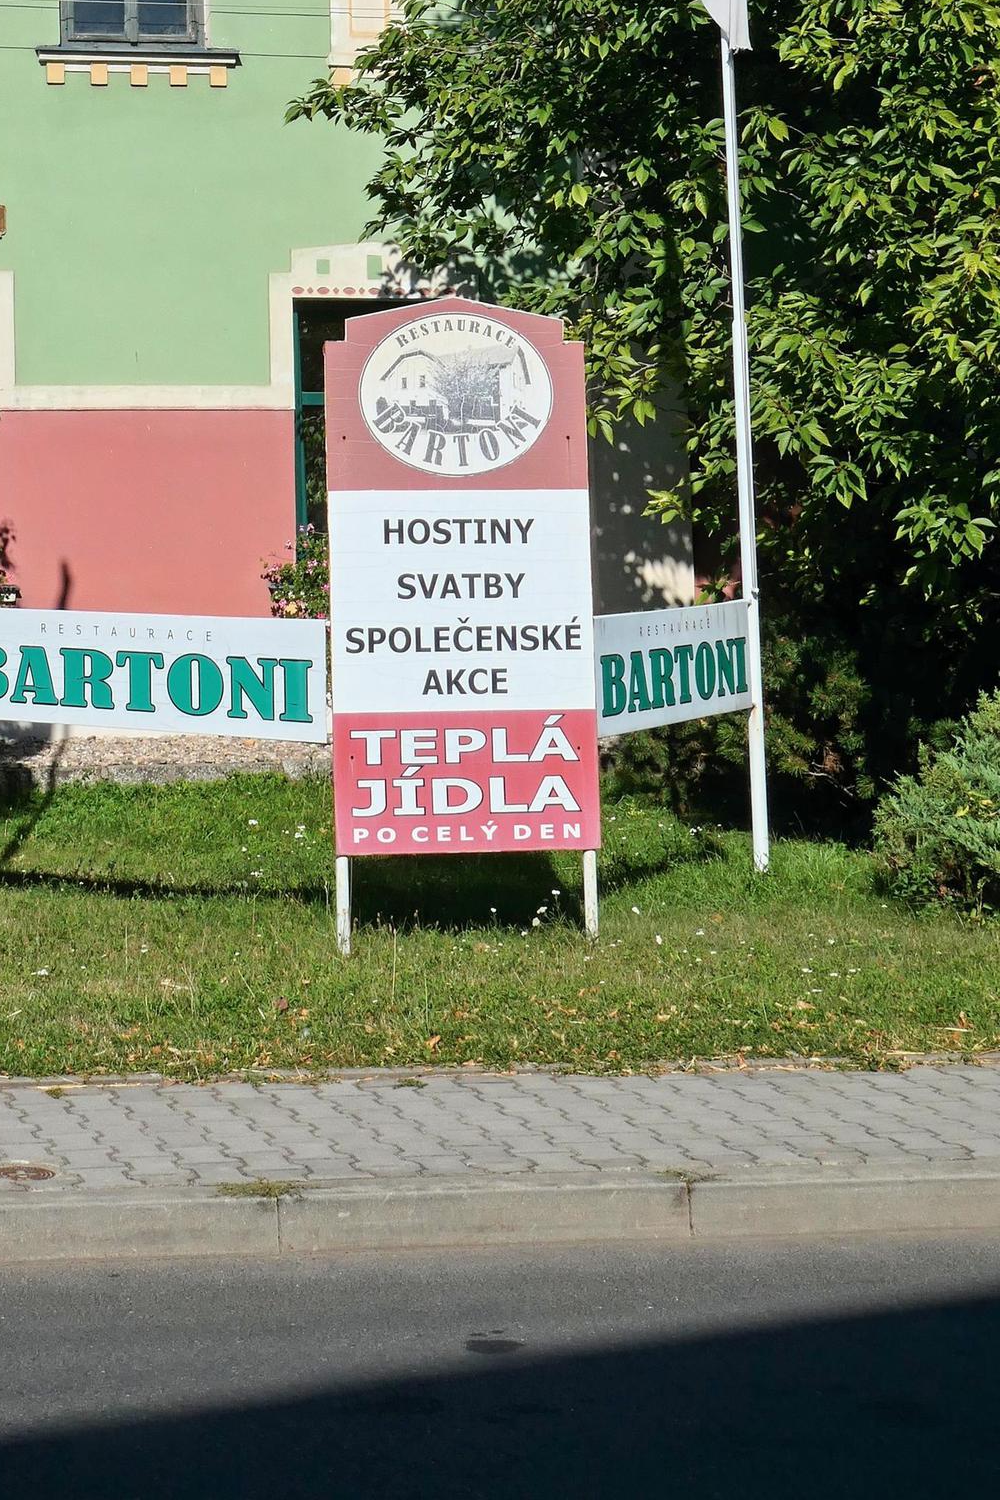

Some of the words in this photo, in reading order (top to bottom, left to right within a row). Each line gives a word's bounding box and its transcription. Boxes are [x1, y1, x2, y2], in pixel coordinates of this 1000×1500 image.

[395, 319, 515, 349] RESTAURACE
[372, 401, 541, 467] BARTONI
[383, 518, 534, 545] HOSTINY
[397, 573, 525, 600] SVATBY
[40, 622, 213, 642] RESTAURACE
[345, 616, 582, 654] SPOLEČENSKÉ
[639, 618, 711, 637] RESTAURACE
[422, 668, 508, 695] AKCE
[600, 637, 748, 718] BARTONI
[350, 714, 580, 766] TEPLÁ
[351, 765, 582, 817] JÍDLA
[353, 826, 397, 843] PO
[411, 820, 498, 842] CELÝ
[514, 823, 581, 840] DEN
